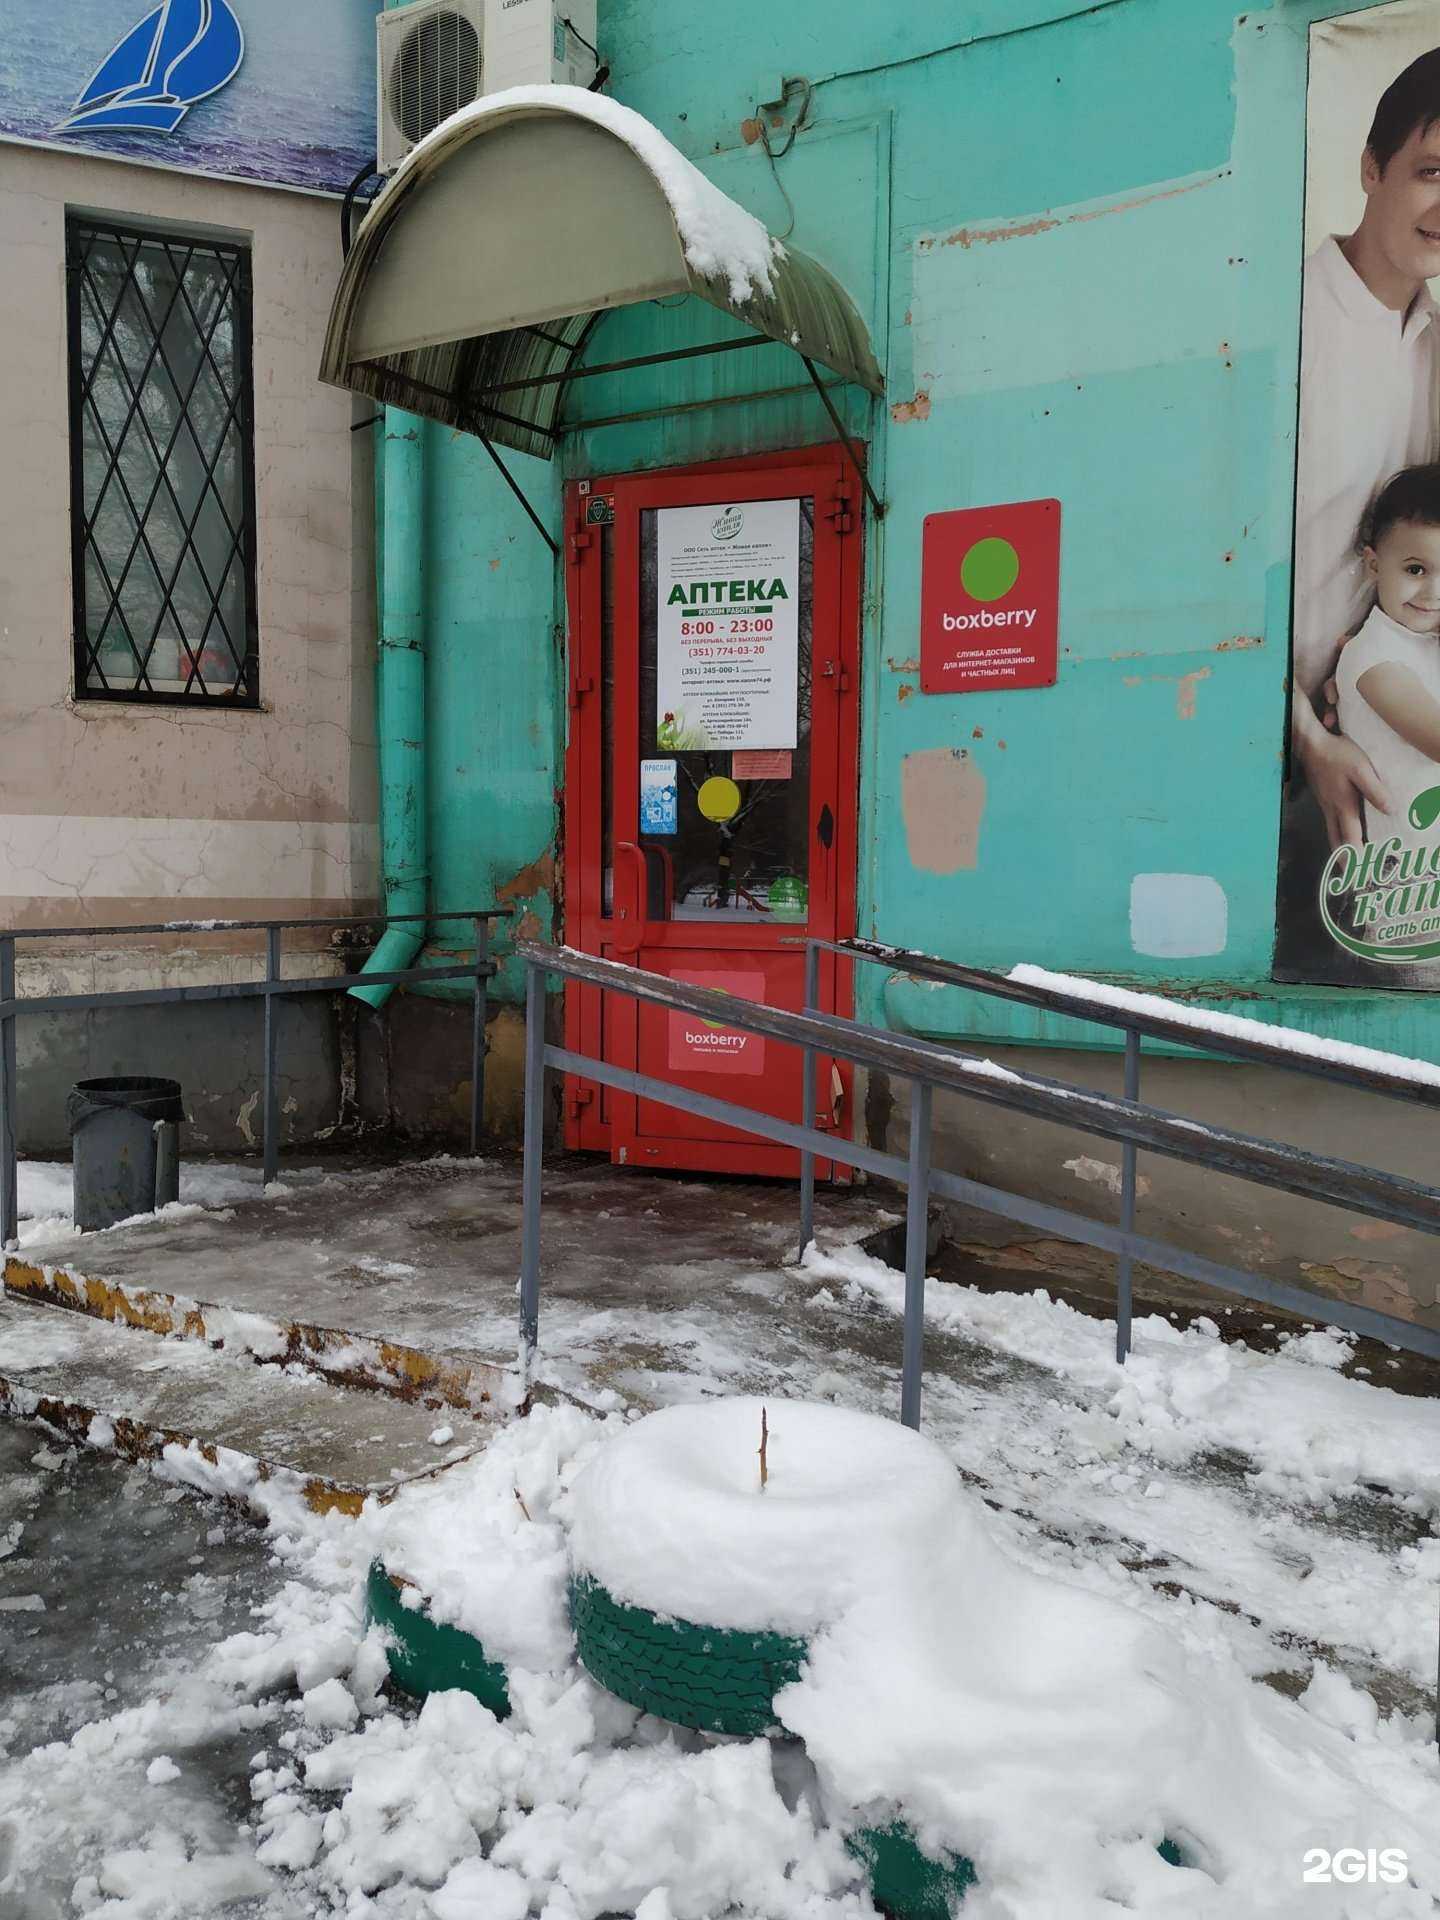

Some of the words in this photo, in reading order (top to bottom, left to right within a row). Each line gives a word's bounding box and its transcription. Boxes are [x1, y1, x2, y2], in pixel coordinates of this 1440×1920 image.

[667, 578, 789, 605] АПТЕКА
[726, 606, 756, 615] РАБОТЫ
[943, 608, 1037, 631] boxberry
[681, 621, 714, 635] 8:00
[730, 618, 774, 633] 23:00
[688, 648, 714, 657] (351)
[716, 645, 765, 656] 774-03-20
[956, 650, 985, 658] СЛУЖБА
[985, 647, 1021, 656] ДОСТАВКИ
[943, 662, 958, 670] ДЛЯ
[958, 656, 1035, 668] ИНТЕРНЕТ-МАГАЗИНОВ
[681, 667, 701, 675] (351)
[703, 665, 740, 674] 245-000-1
[967, 668, 999, 677] ЧАСТНЫХ
[1000, 667, 1016, 676] ЛИЦ
[685, 1031, 747, 1049] boxberry
